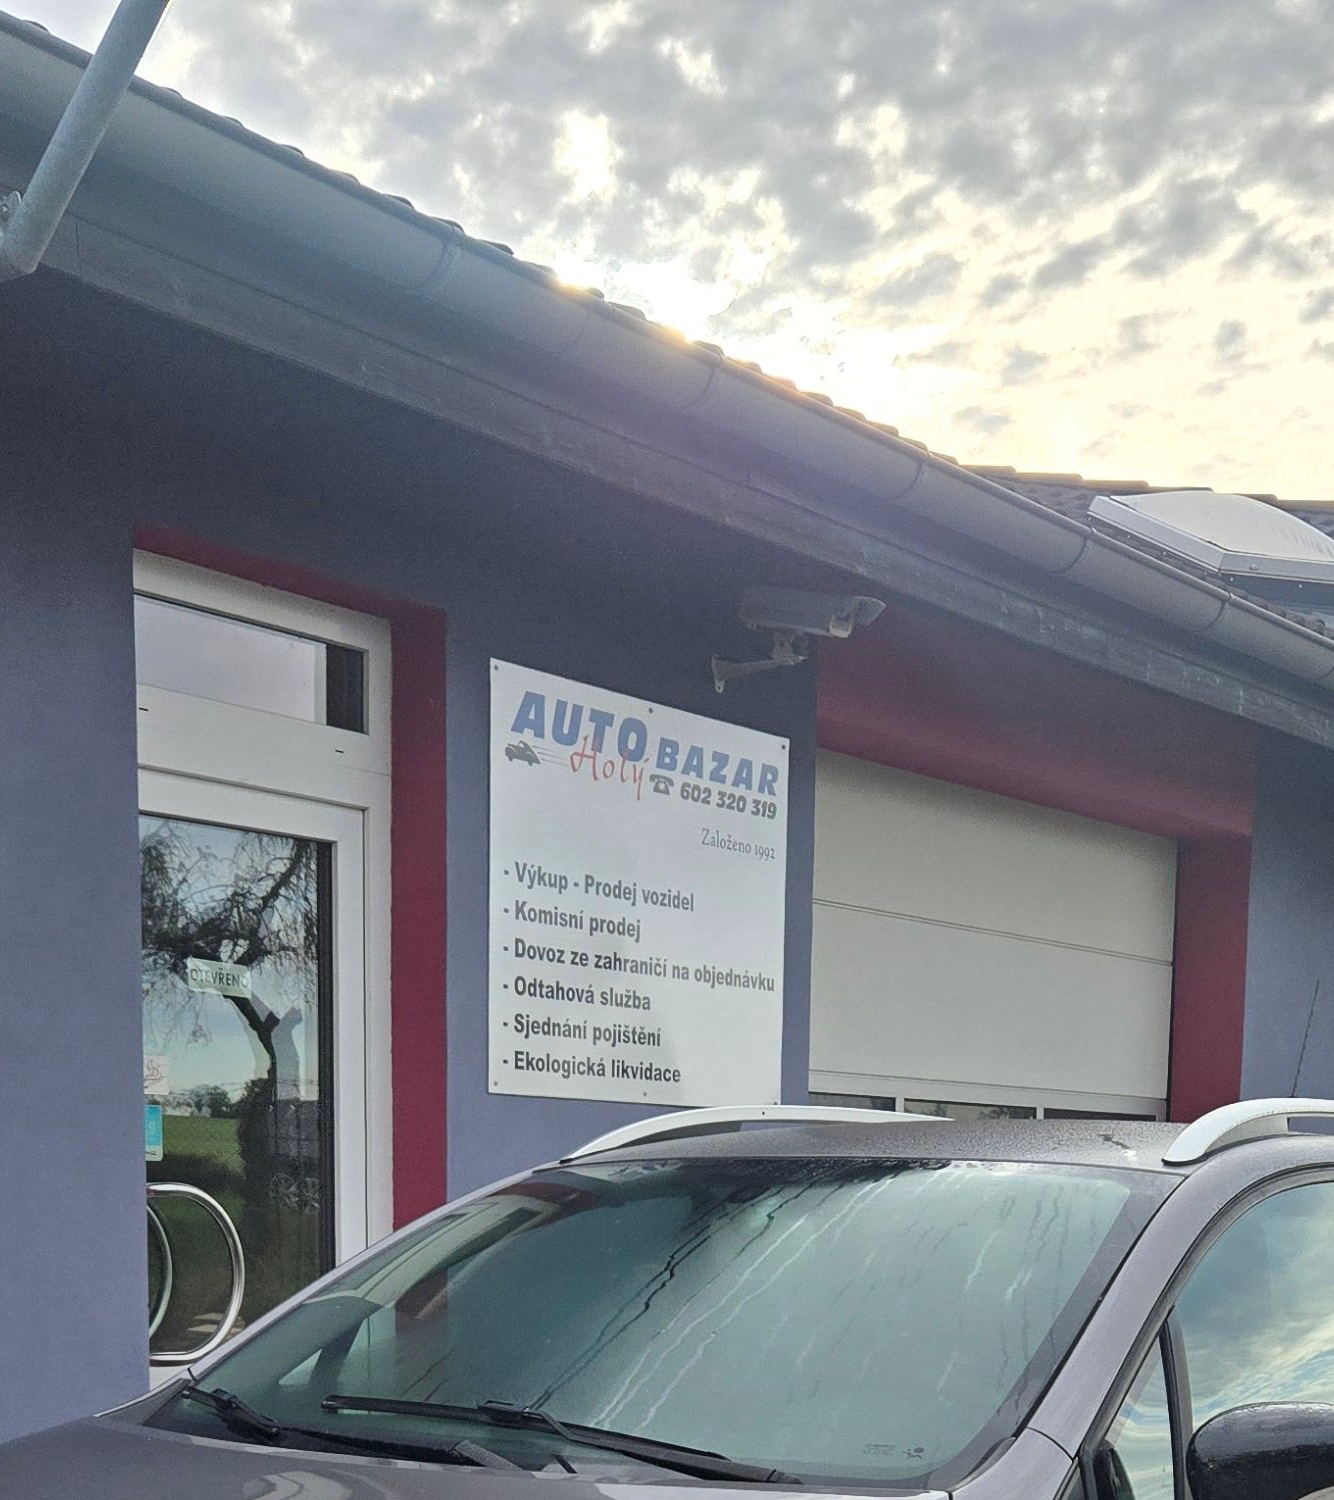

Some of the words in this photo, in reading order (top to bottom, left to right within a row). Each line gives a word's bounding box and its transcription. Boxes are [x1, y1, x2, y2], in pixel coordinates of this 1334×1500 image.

[511, 691, 648, 762] AUTO
[656, 737, 779, 797] BAZAR
[570, 734, 650, 801] Holý
[680, 782, 712, 806] 602
[716, 790, 747, 813] 320
[751, 798, 778, 820] 319
[701, 827, 752, 855] Založeno
[754, 844, 776, 861] 1992
[514, 861, 568, 895] Výkup
[584, 873, 637, 907] Prodej
[642, 889, 694, 912] vozidel
[514, 899, 584, 930] Komisní
[589, 916, 641, 943] prodej
[514, 937, 566, 964] Dovoz
[570, 950, 589, 967] ze
[594, 951, 668, 978] zahraničí
[672, 964, 690, 981] na
[694, 964, 775, 992] objednávku
[514, 975, 595, 1005] Odtahová
[600, 987, 651, 1011] služba
[514, 1013, 588, 1040] Sjednání
[592, 1024, 661, 1048] pojištění
[514, 1050, 606, 1080] Ekologická
[611, 1058, 682, 1083] likvidace
